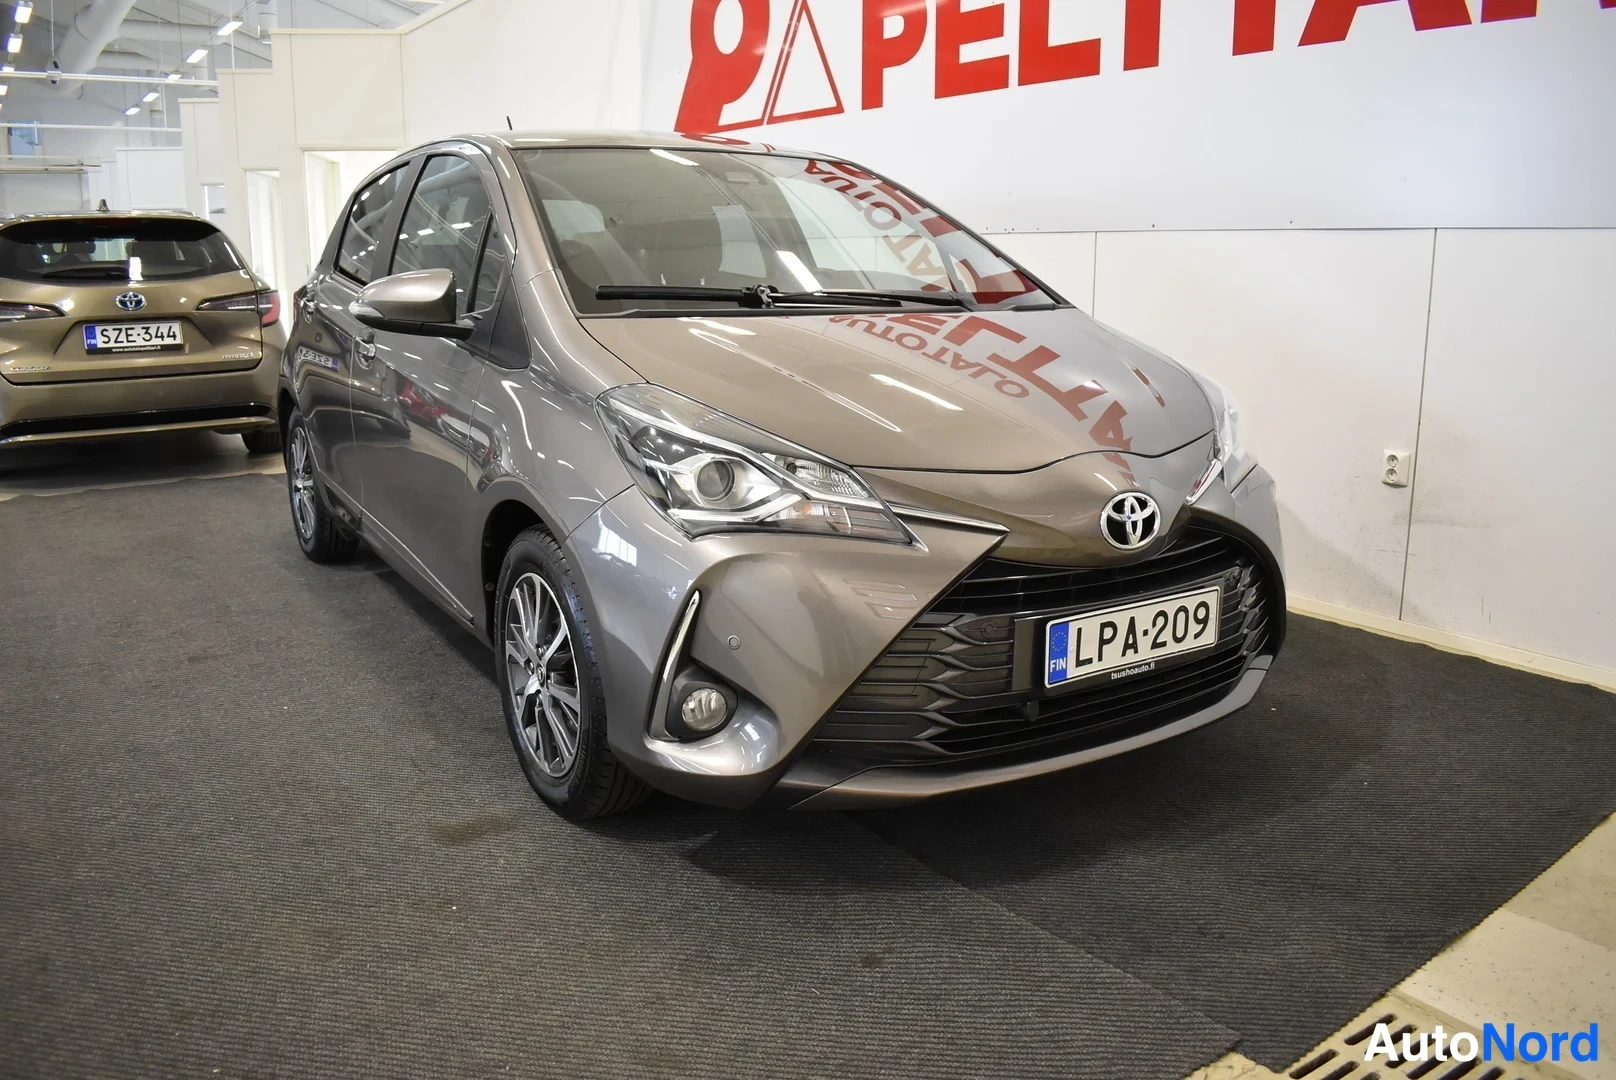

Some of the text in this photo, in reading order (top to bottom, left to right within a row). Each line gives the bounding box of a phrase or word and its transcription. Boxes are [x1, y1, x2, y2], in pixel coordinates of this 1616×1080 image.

[100, 325, 178, 345] SZE-344
[1074, 600, 1210, 668] LPA-209
[1050, 656, 1067, 673] FIN
[1110, 661, 1155, 680] tsushoauto.fi
